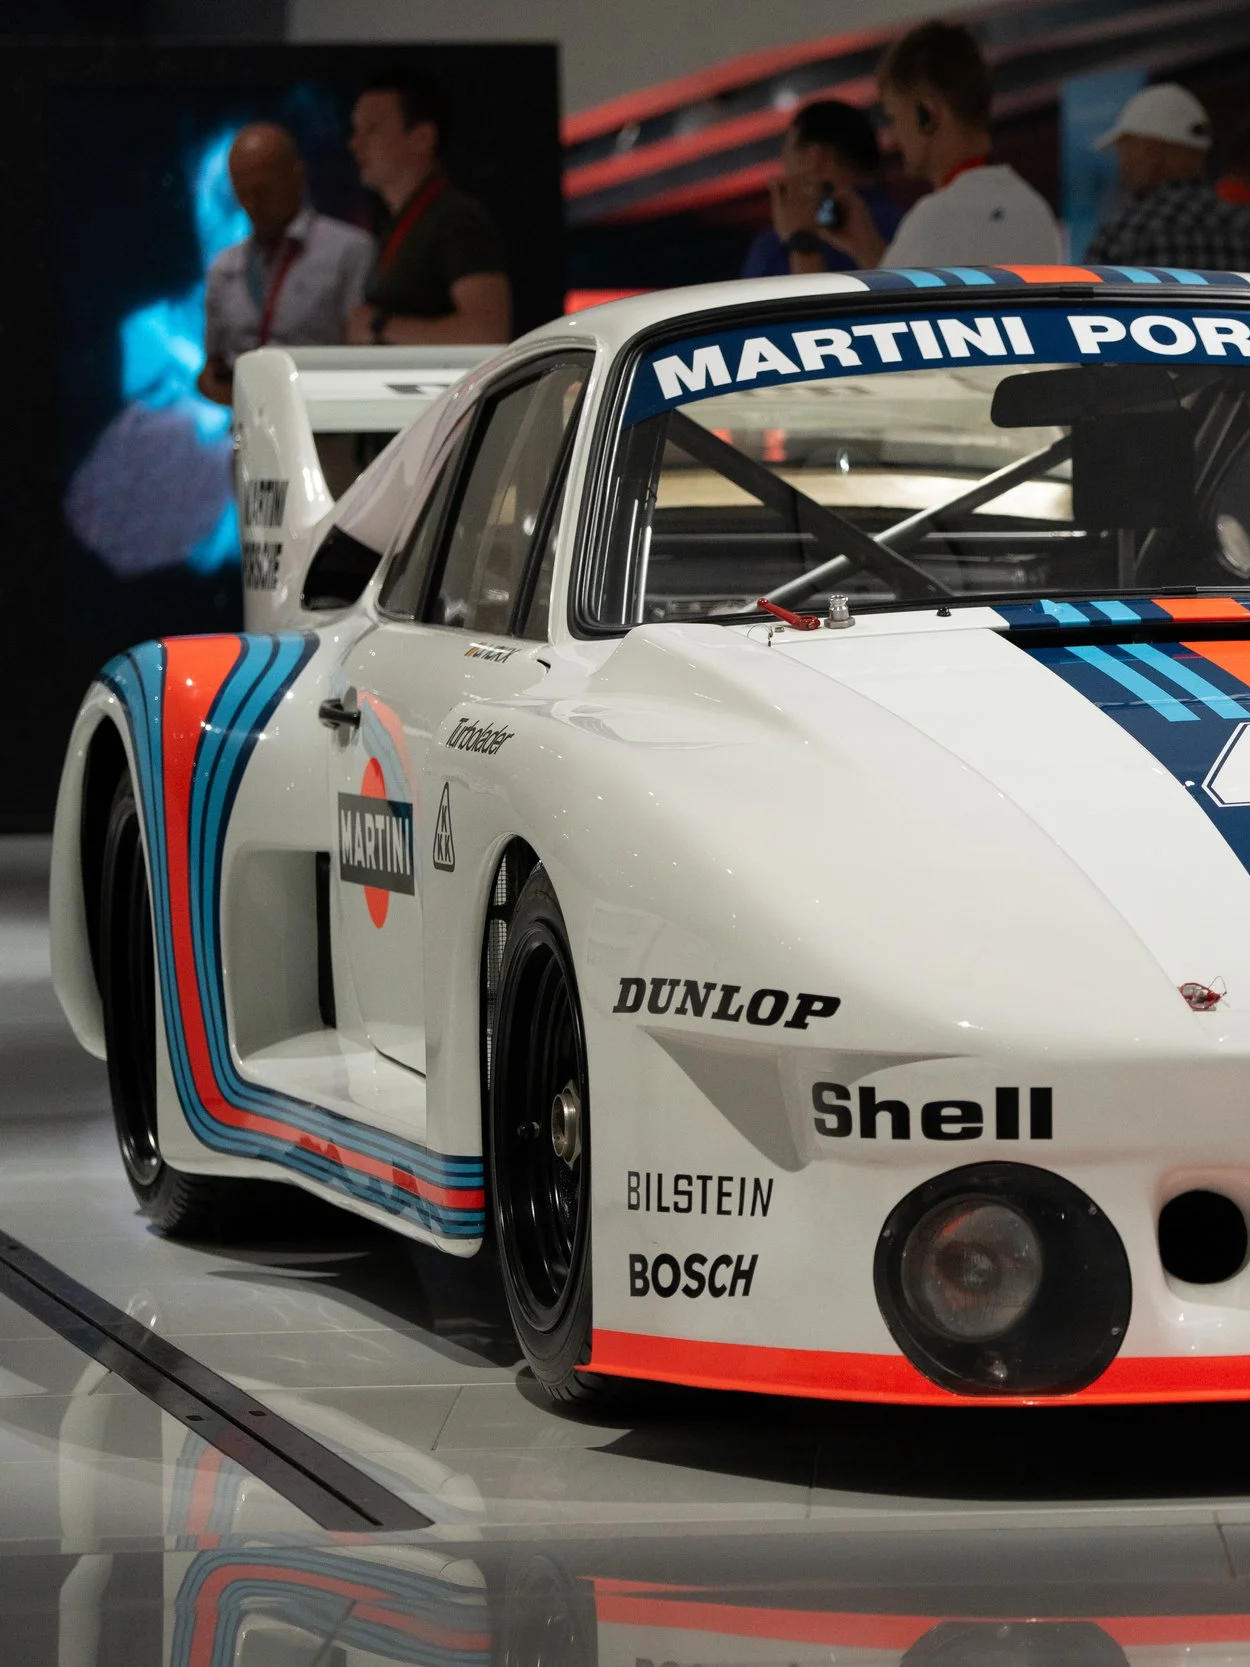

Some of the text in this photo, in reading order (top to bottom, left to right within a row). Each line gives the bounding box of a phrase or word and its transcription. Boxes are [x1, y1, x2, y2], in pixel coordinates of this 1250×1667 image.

[652, 315, 1035, 400] MARTINI
[446, 717, 516, 756] Turbolader
[340, 807, 412, 876] MARTINI
[612, 977, 841, 1030] DUNLOP
[812, 1082, 1054, 1141] Shell
[626, 1170, 774, 1217] BILSTEIN
[628, 1253, 758, 1299] BOSCH
